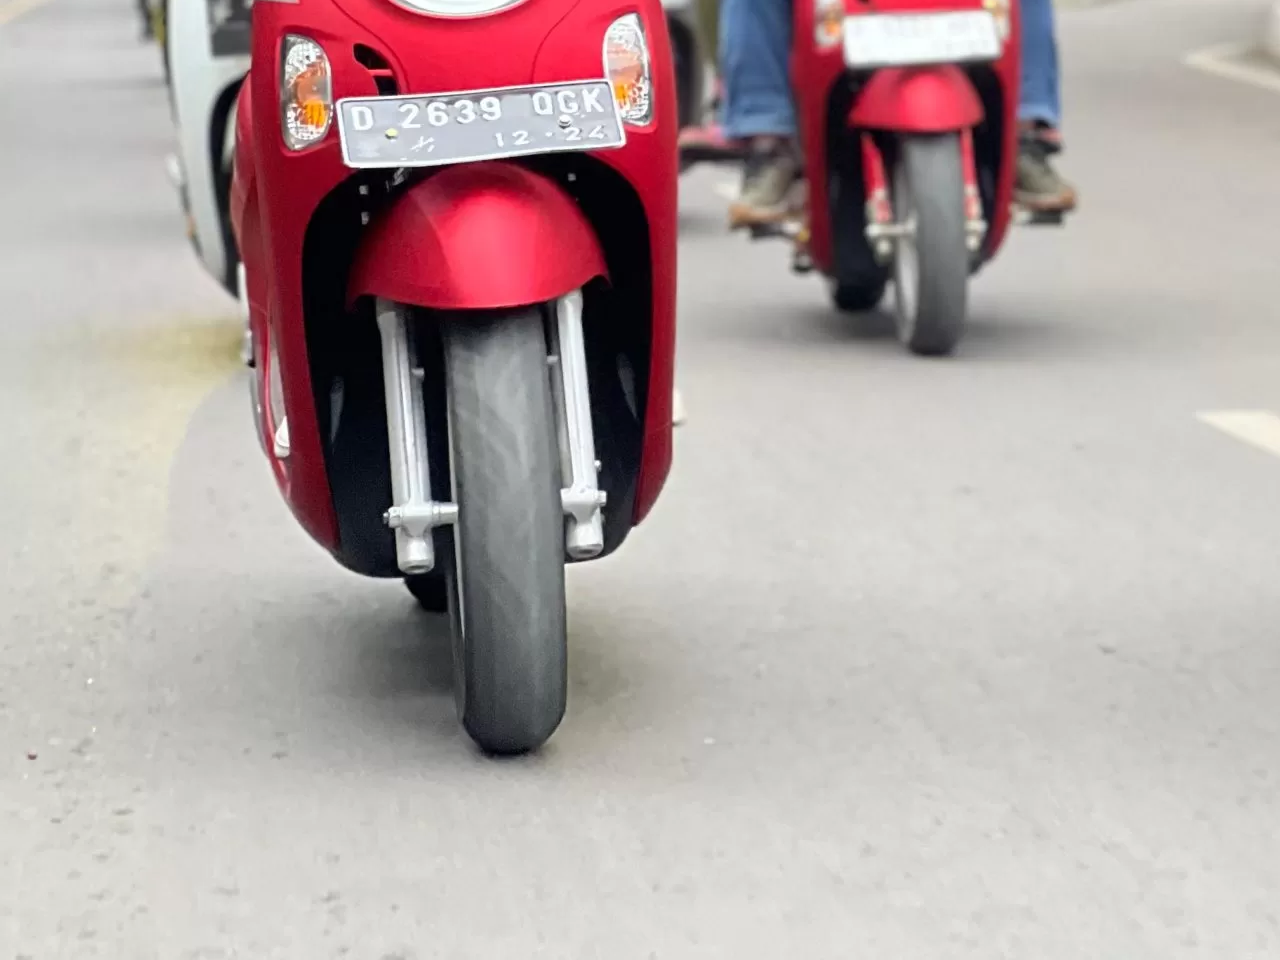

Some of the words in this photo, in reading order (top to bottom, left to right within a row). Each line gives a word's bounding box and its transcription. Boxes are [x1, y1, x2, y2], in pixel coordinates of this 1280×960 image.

[350, 104, 375, 132] D
[398, 96, 502, 129] 2639
[532, 91, 605, 116] QGK
